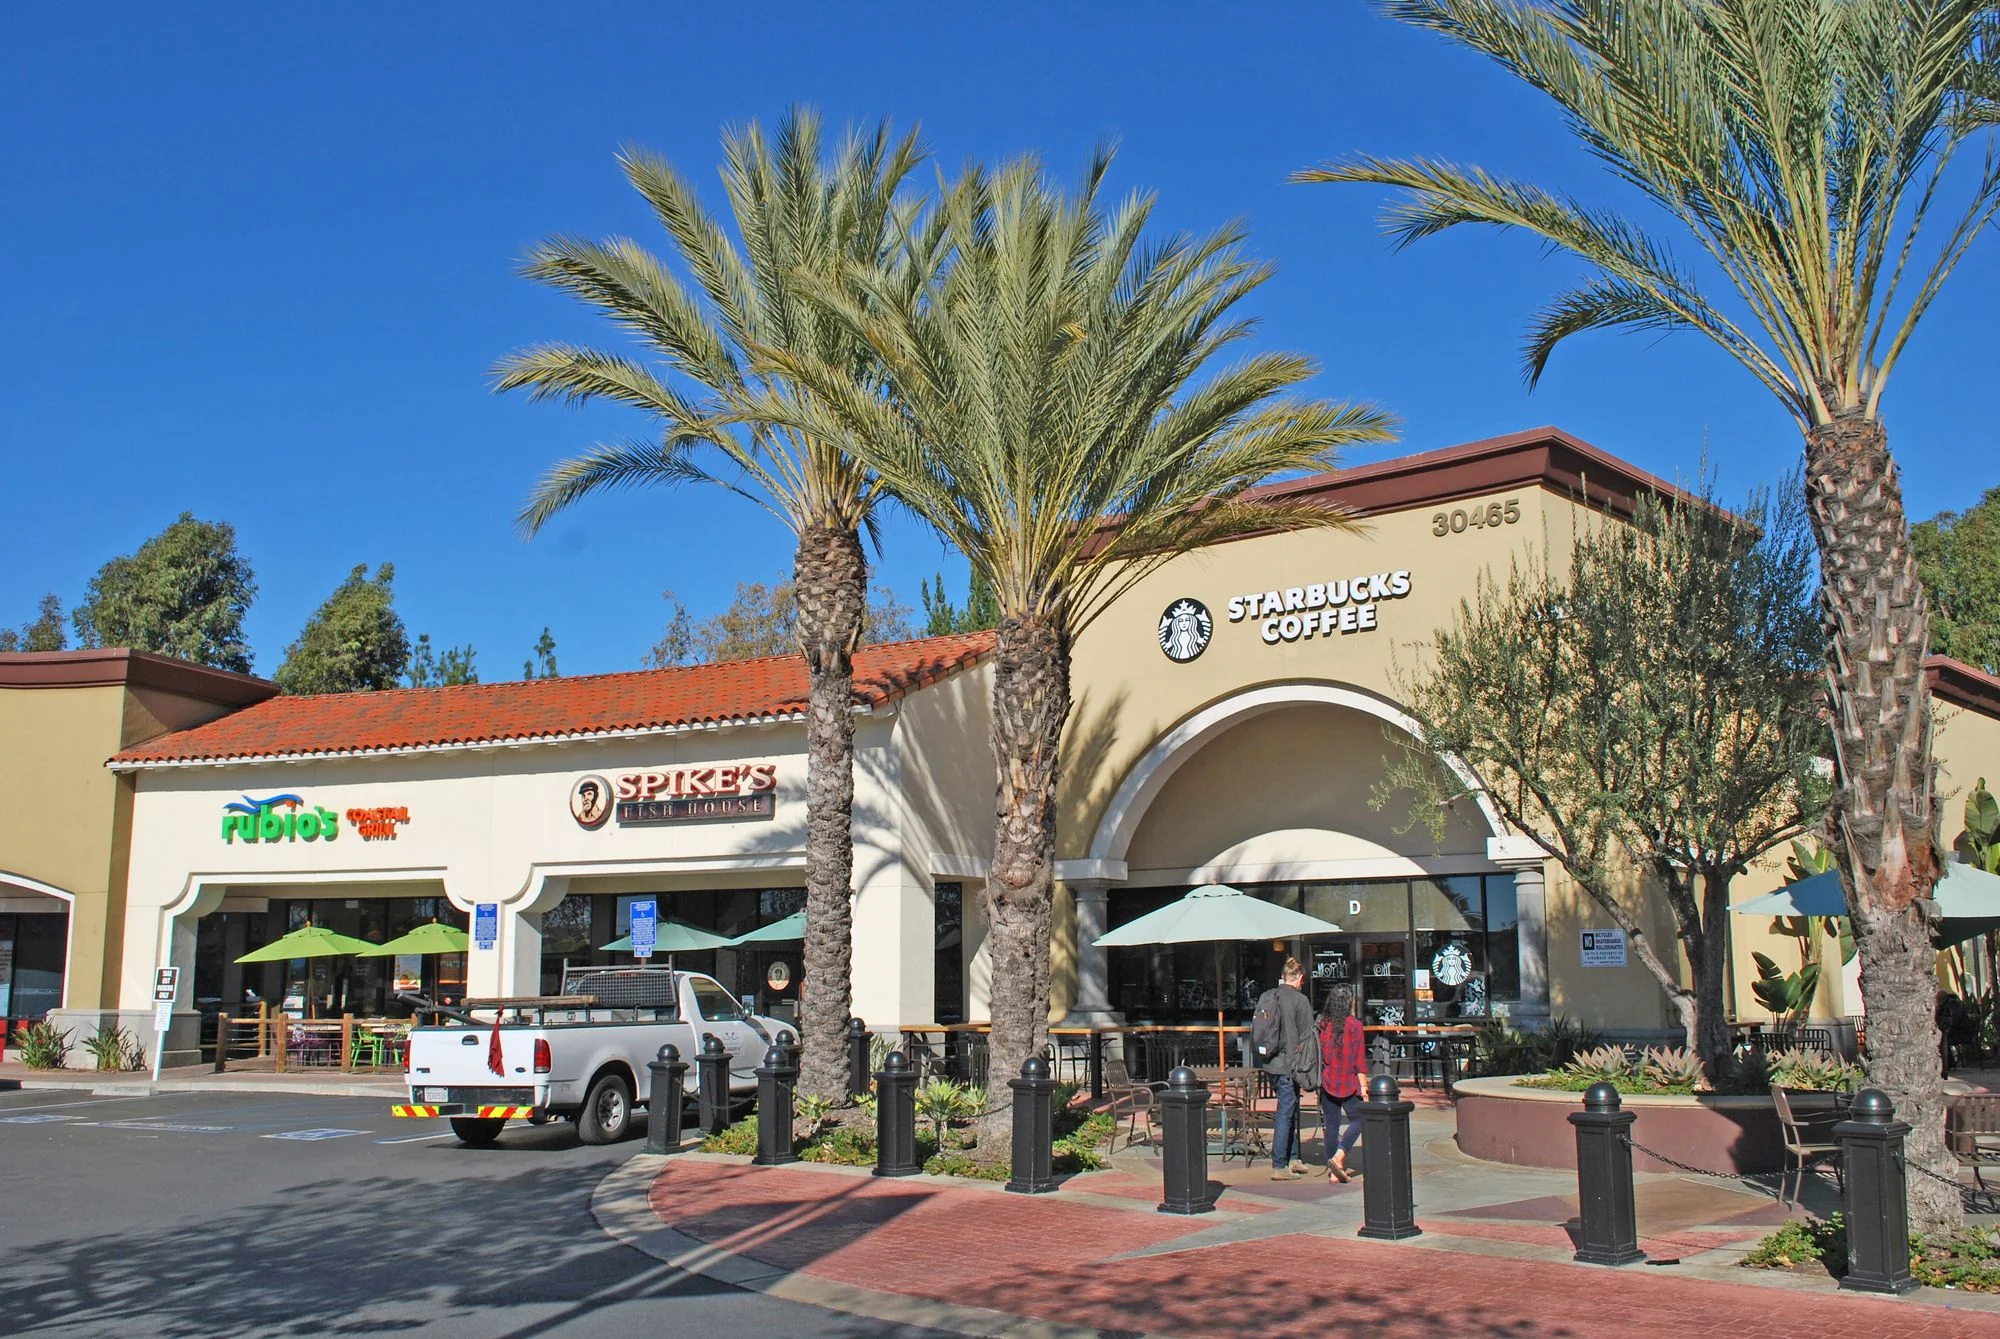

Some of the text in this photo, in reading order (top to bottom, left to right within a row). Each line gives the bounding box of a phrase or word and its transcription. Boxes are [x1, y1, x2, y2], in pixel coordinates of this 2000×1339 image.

[1432, 498, 1521, 537] 30465
[1228, 570, 1412, 623] STARBUCKS
[1261, 603, 1378, 645] COFFEE
[615, 763, 777, 800] SPIKE'S
[221, 801, 339, 843] rubio's
[346, 806, 411, 823] COASTAL
[623, 799, 762, 819] FISH HOUSE
[358, 822, 398, 839] GRILL
[1349, 899, 1361, 915] D
[1584, 935, 1593, 948] NO
